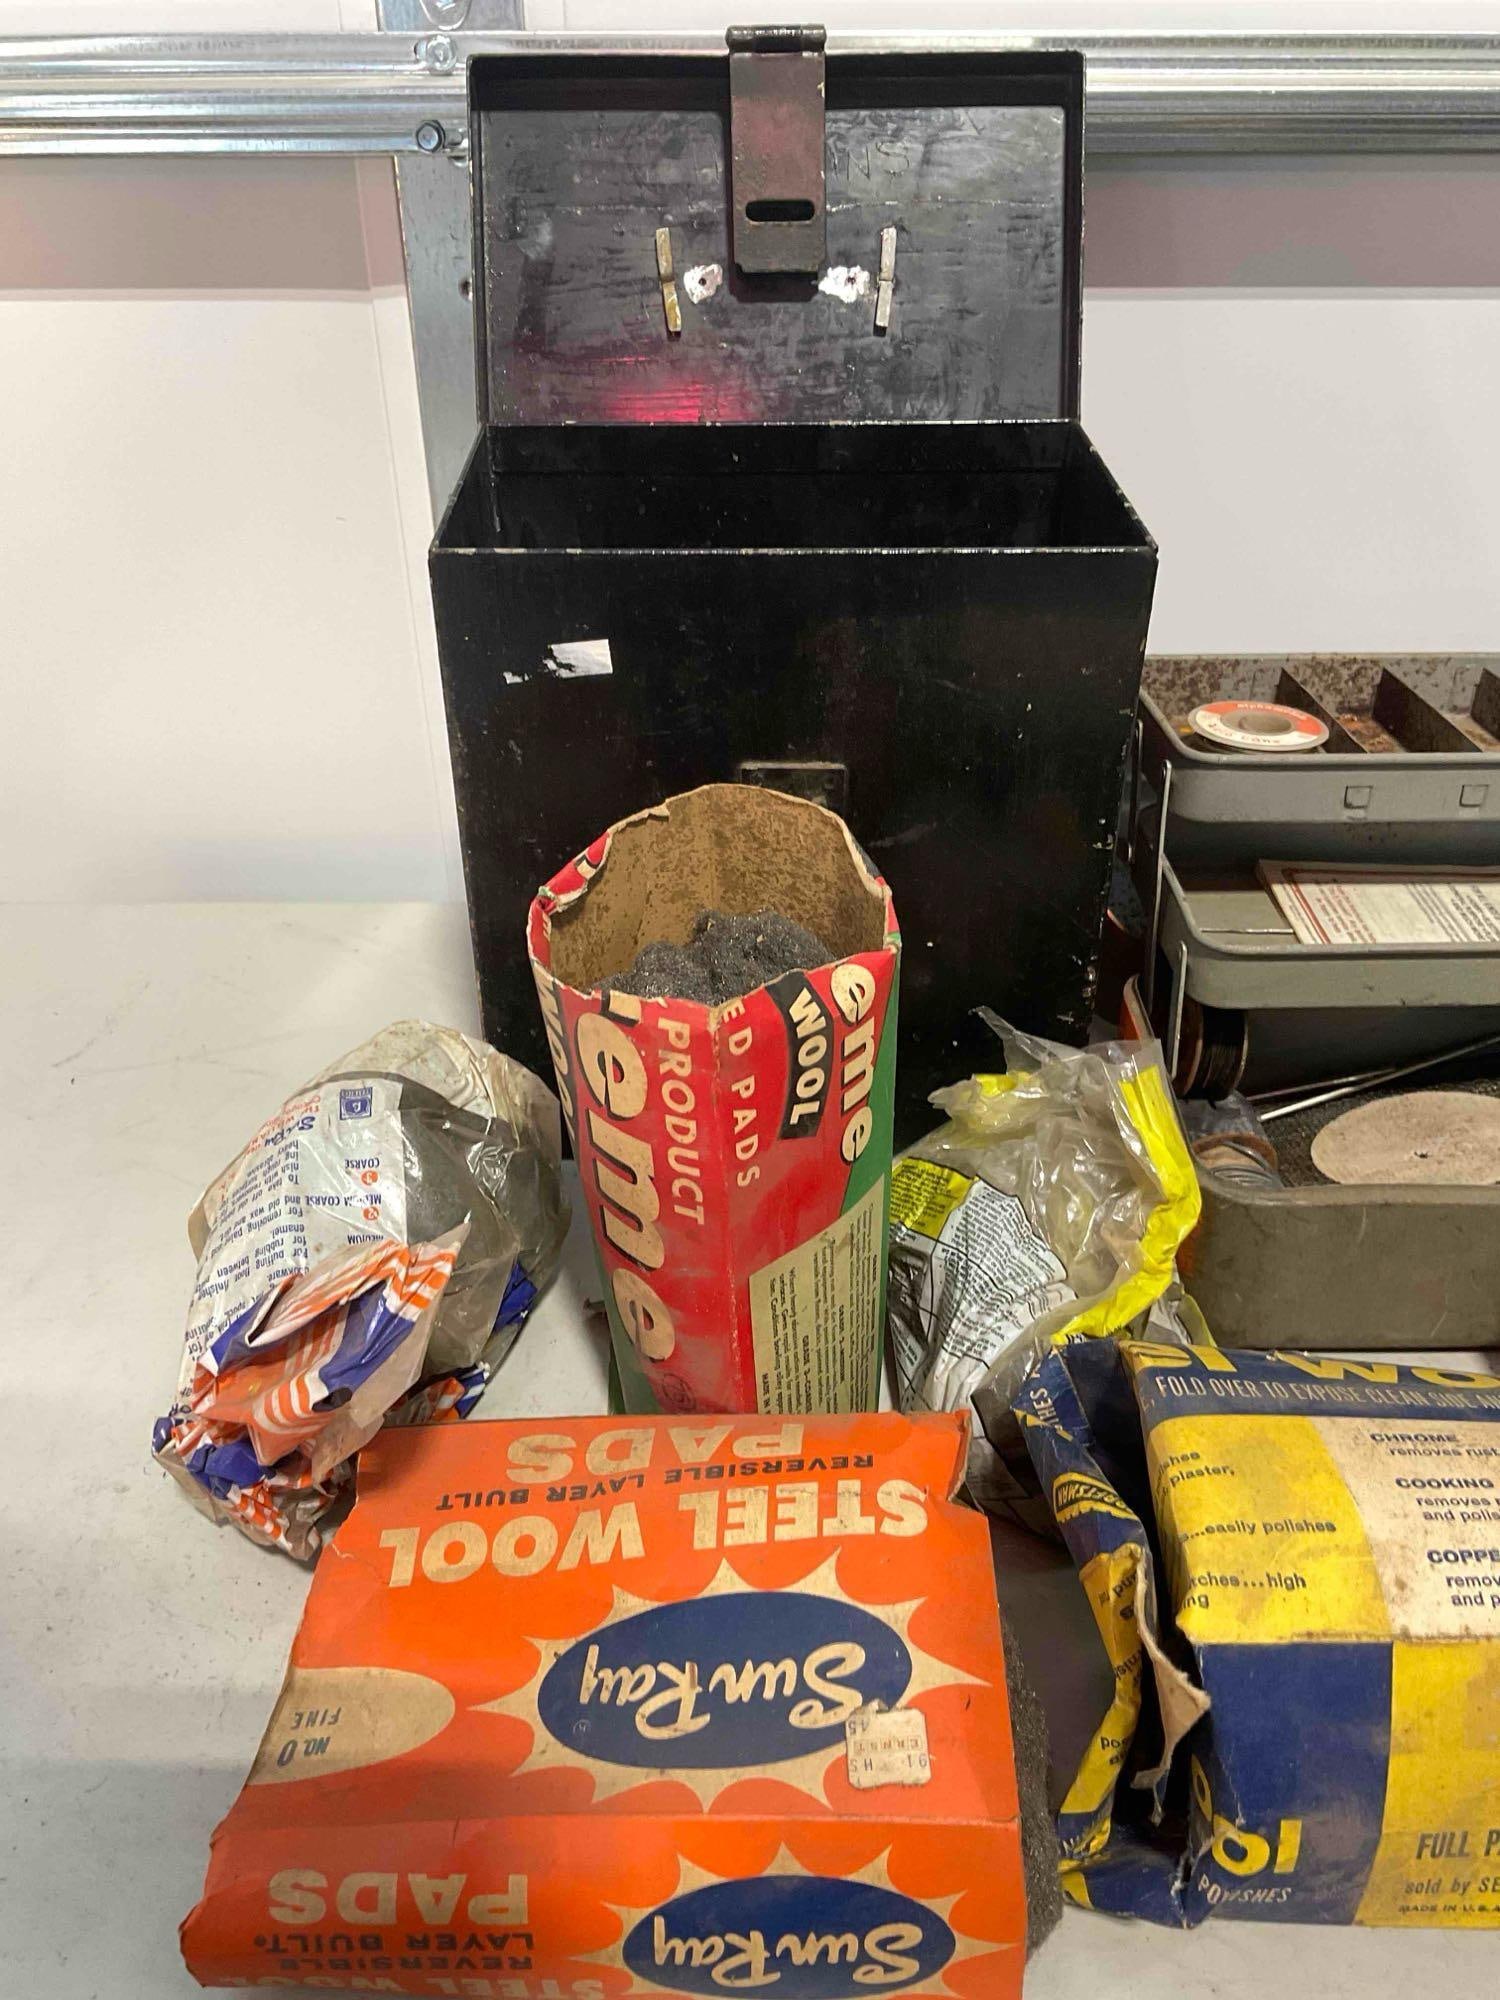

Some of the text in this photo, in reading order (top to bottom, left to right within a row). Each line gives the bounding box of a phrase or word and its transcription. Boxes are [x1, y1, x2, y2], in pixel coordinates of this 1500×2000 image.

[788, 988, 827, 1126] WOOL
[658, 1017, 704, 1225] PRODUCT
[731, 1078, 760, 1188] PADS
[345, 1159, 380, 1170] COARSE
[268, 1197, 280, 1210] old
[284, 1195, 300, 1205] and
[250, 1207, 264, 1219] wax
[288, 1206, 303, 1216] For
[247, 1209, 281, 1232] removing
[255, 1240, 284, 1256] rubbing
[292, 1236, 307, 1245] for
[217, 1256, 249, 1277] between
[1155, 1375, 1207, 1398] FOLD
[1208, 1378, 1262, 1398] OVER
[1260, 1381, 1288, 1399] TO
[1289, 1383, 1363, 1402] EXPOSE
[1365, 1388, 1430, 1407] CLEAN
[1475, 1394, 1500, 1409] AN
[1370, 1433, 1458, 1442] CHROME
[507, 1424, 803, 1484] PADS
[1390, 1448, 1462, 1457] removes
[436, 1454, 874, 1512] REVERSIBLE LAYER BUILT
[1169, 1464, 1235, 1488] plaster,
[1395, 1478, 1494, 1490] COOKING
[1416, 1498, 1490, 1507] removes
[1423, 1510, 1455, 1521] and
[380, 1479, 928, 1588] STEEL WOOL
[1262, 1519, 1337, 1536] polishes
[1452, 1592, 1485, 1606] and
[290, 1706, 341, 1730] FINE
[1416, 1831, 1470, 1860] FULL
[1404, 1878, 1442, 1895] sold
[1451, 1877, 1471, 1896] by
[268, 1871, 531, 1925] PADS
[1399, 1904, 1438, 1913] MADE
[1443, 1904, 1457, 1912] IN
[406, 1933, 533, 1953] LAYER
[280, 1956, 532, 1970] REVERSIBLE
